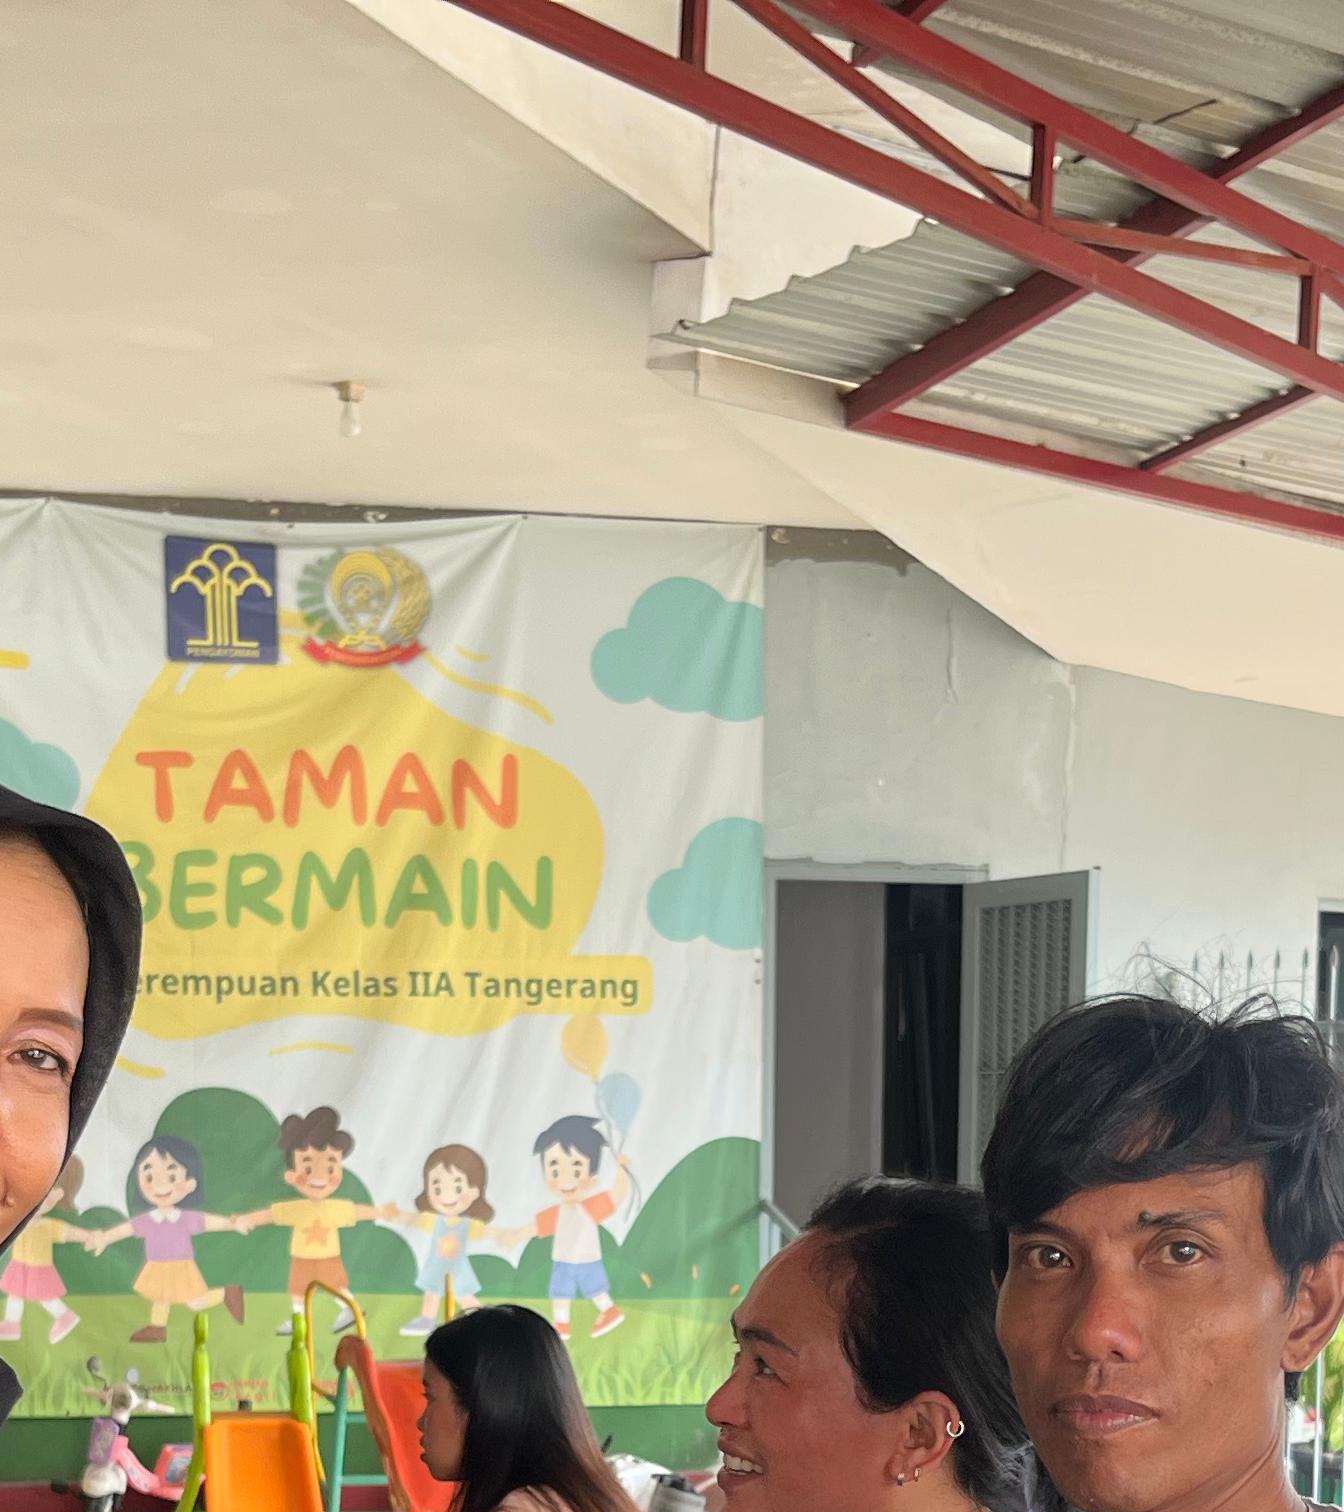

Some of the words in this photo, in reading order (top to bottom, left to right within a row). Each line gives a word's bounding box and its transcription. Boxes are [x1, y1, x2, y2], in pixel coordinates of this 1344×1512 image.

[134, 744, 520, 830] TAMAN
[120, 841, 555, 933] BERMAIN
[311, 970, 398, 997] Kelas
[408, 972, 455, 998] IIA
[464, 972, 640, 1006] Tangerang
